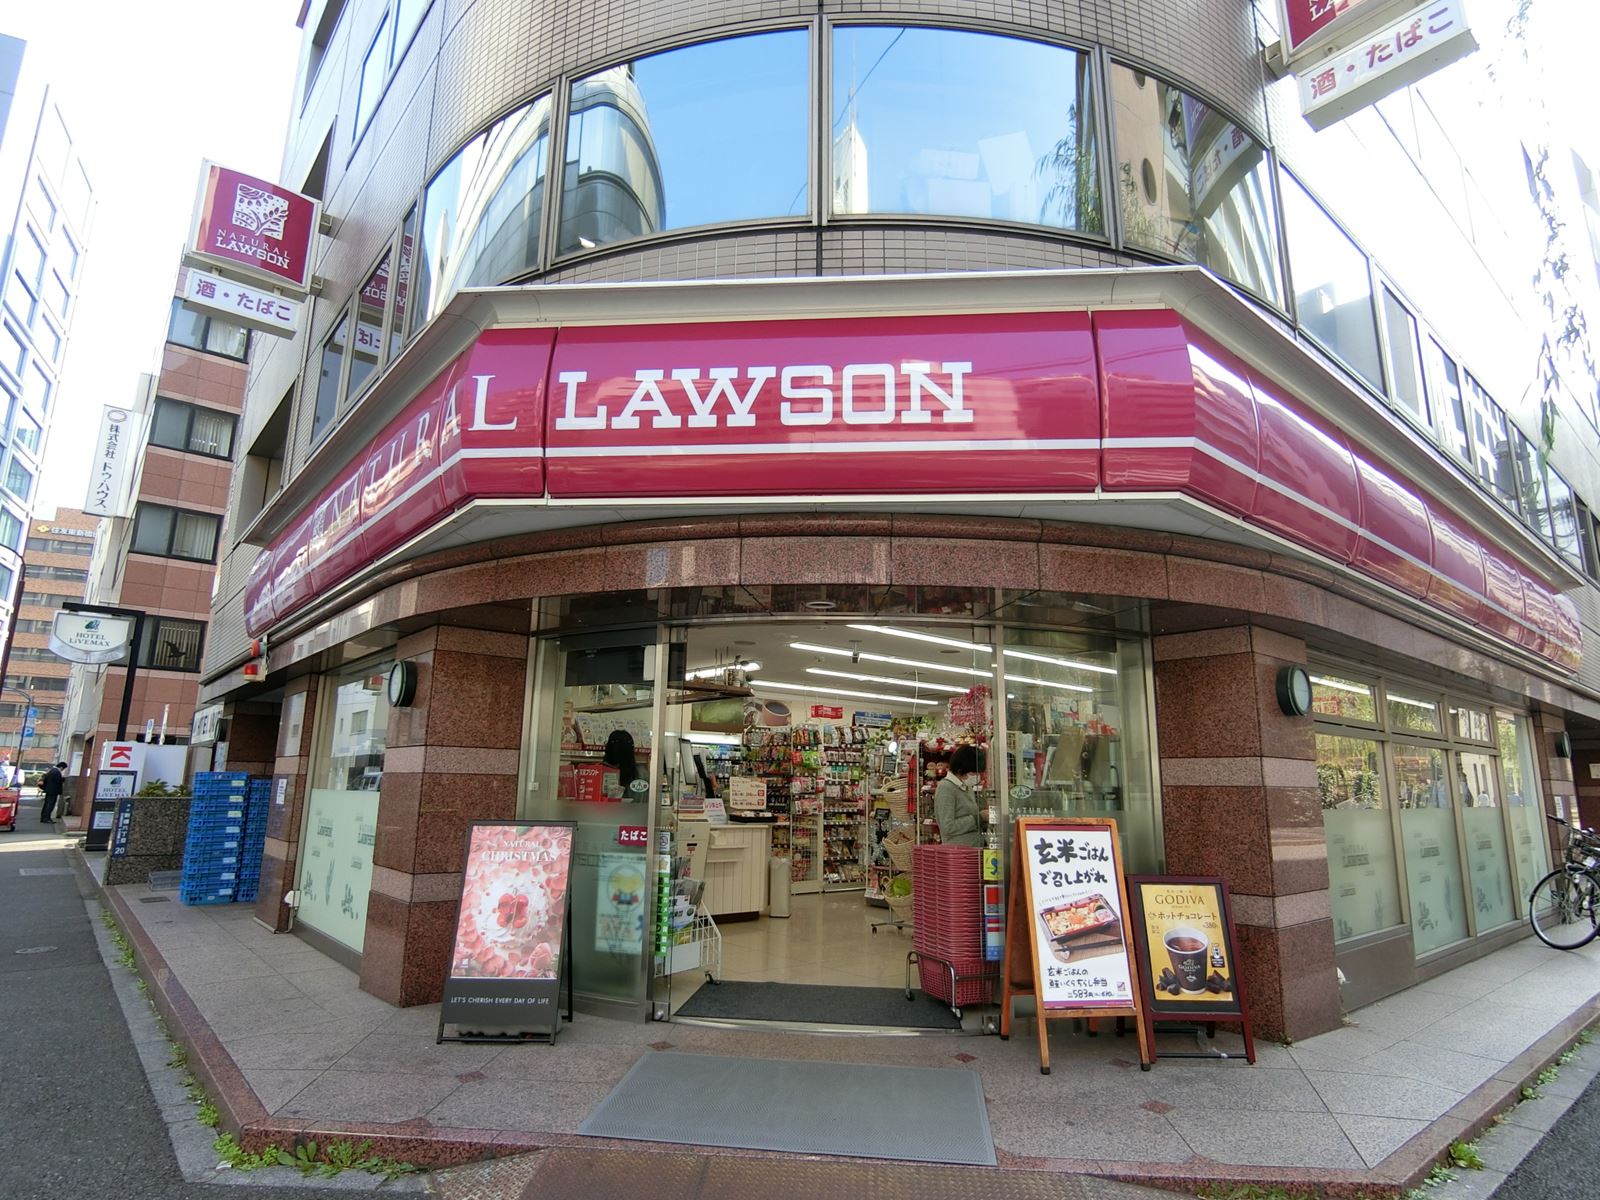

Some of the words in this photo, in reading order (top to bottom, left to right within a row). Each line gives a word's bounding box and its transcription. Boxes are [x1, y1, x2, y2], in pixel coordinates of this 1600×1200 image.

[1310, 7, 1454, 99] 酒・たばこ
[216, 237, 289, 269] LAWSON
[217, 229, 291, 259] NATURAL
[196, 279, 291, 321] 酒・たばこ
[104, 424, 121, 459] 株式会社
[330, 375, 518, 524] NATURAL
[555, 361, 974, 430] LAWSON
[76, 632, 106, 640] HOTEL
[620, 830, 647, 840] たばこ
[114, 846, 125, 854] 20
[481, 850, 556, 861] CHRISTMAS
[1034, 838, 1109, 865] 玄米ごはん
[1039, 868, 1108, 887] で召し上がれ
[1155, 894, 1205, 905] GODIVA
[1158, 911, 1217, 921] ホットチョコレート
[1048, 965, 1089, 977] 玄米ごはんの
